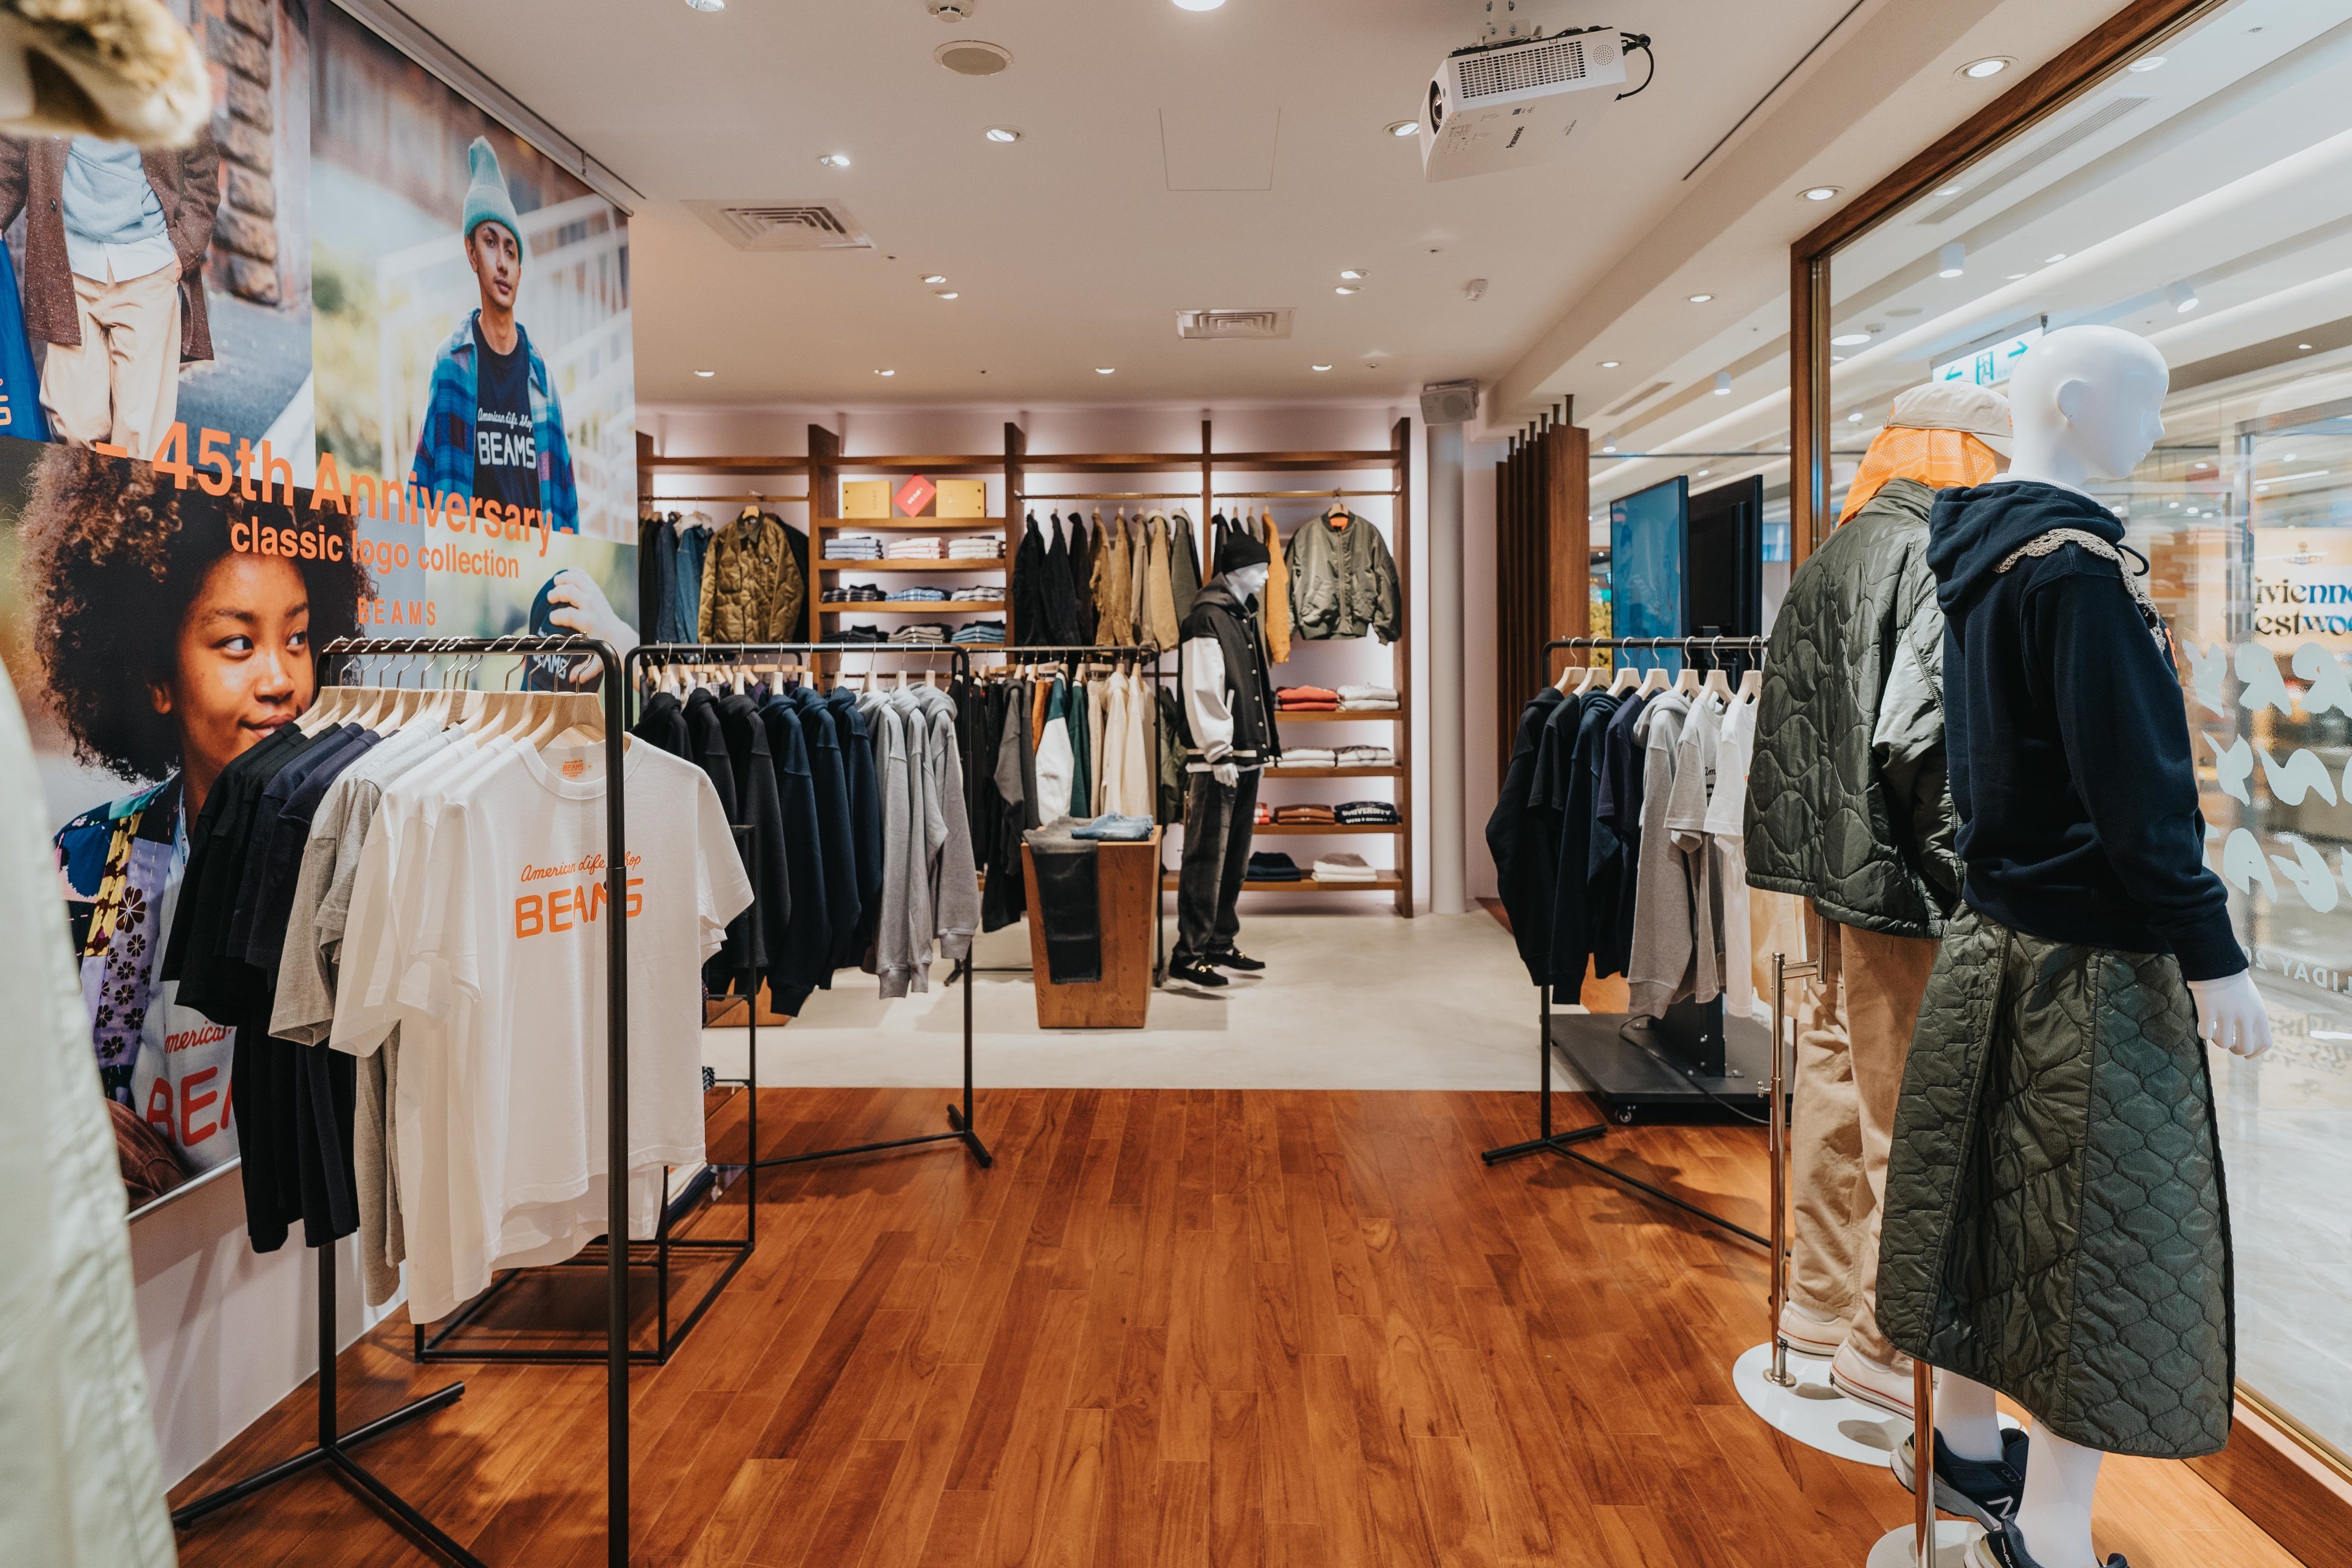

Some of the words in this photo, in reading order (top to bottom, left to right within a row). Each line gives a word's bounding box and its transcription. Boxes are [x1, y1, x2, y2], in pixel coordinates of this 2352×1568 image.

[1505, 125, 1525, 148] Panasonic
[476, 431, 537, 470] BEAMS
[153, 421, 294, 506] 45th
[309, 452, 553, 557] Anniversary
[230, 516, 344, 562] classic
[352, 530, 410, 575] logo
[417, 543, 519, 578] collection
[2254, 577, 2352, 604] ivienn
[358, 598, 437, 626] BEAMS
[562, 763, 584, 772] BEAMS
[520, 861, 576, 882] American
[578, 853, 605, 876] Life
[164, 1020, 233, 1054] merica
